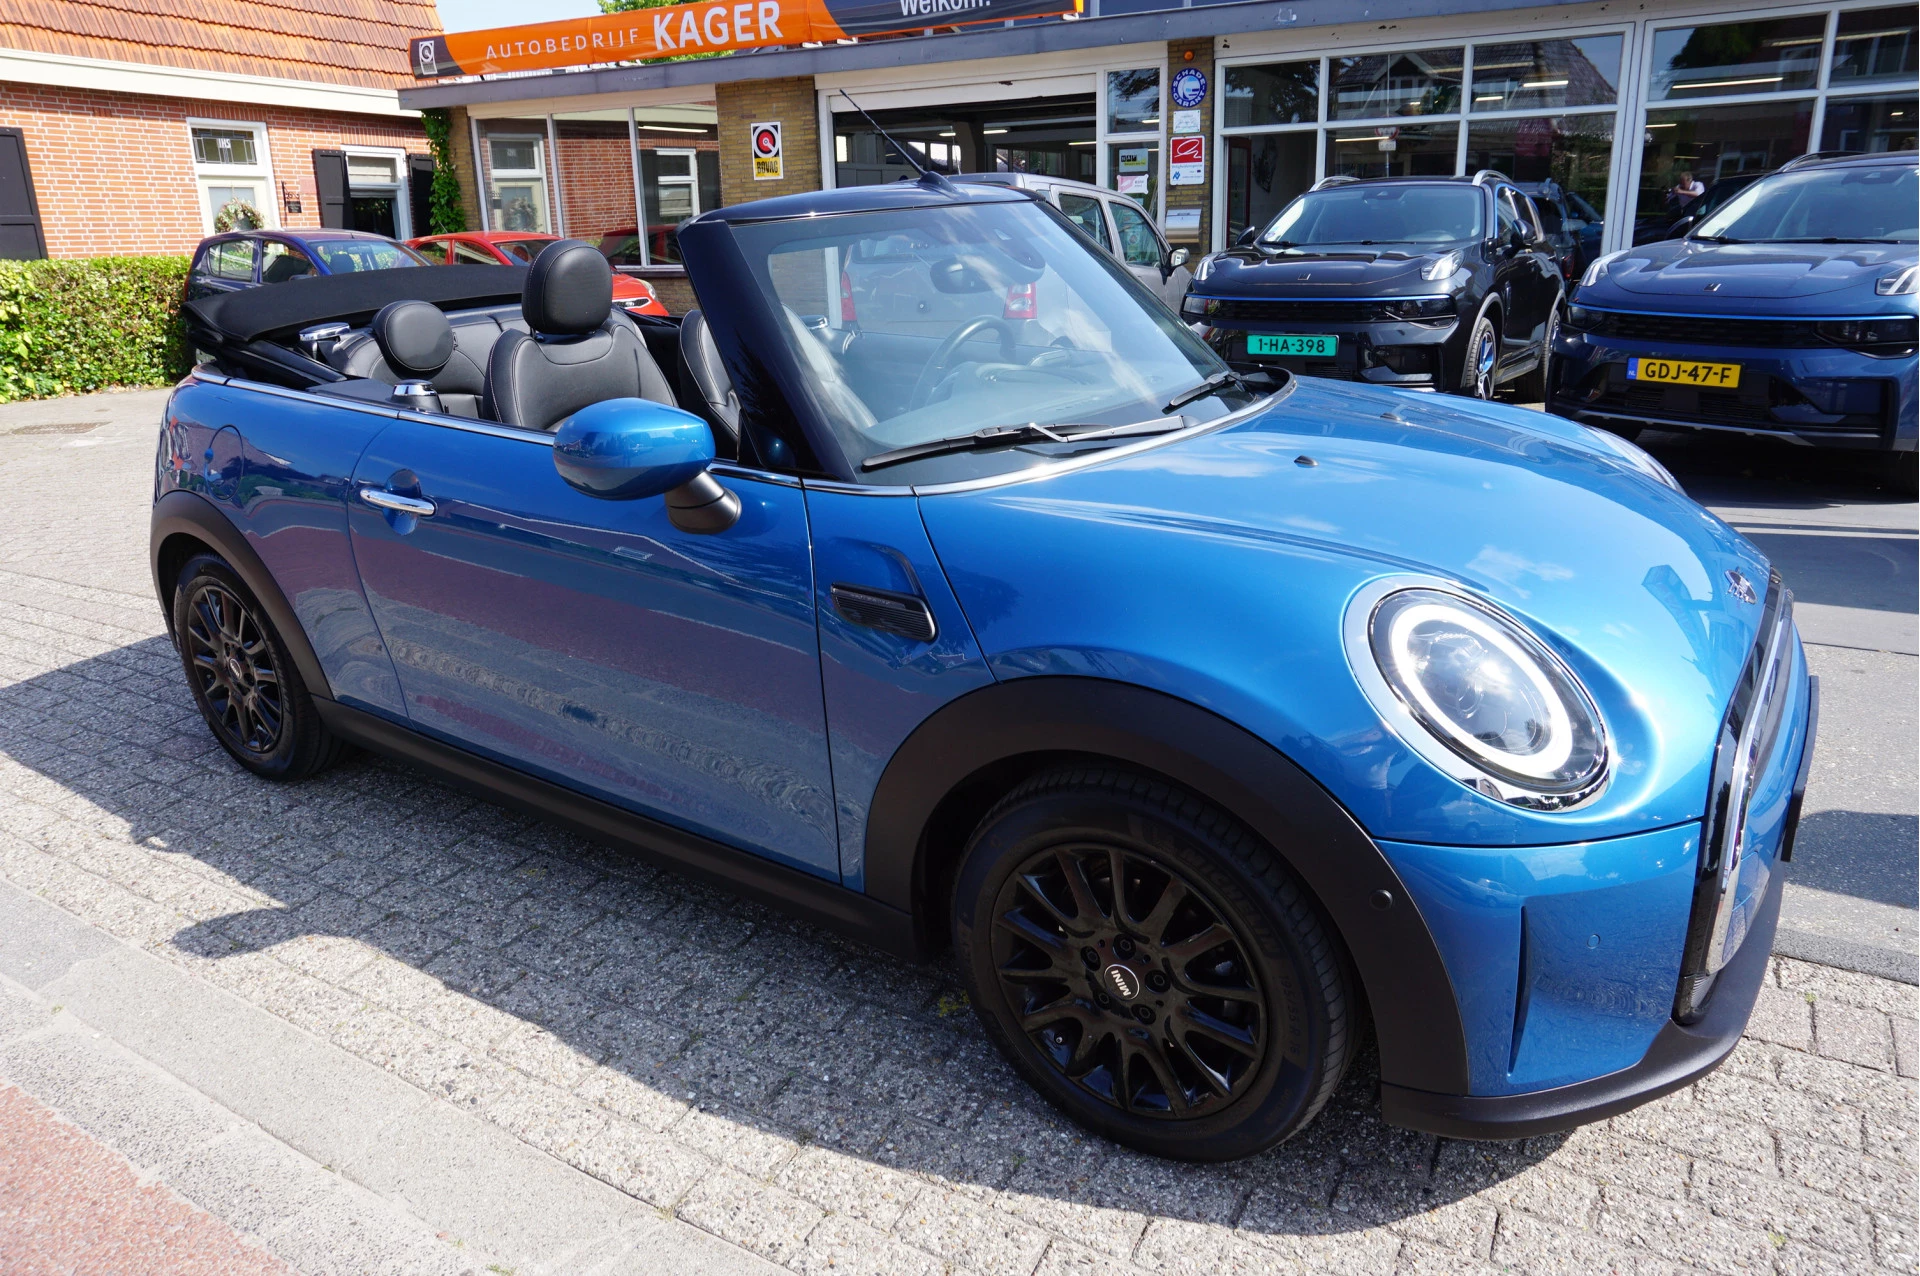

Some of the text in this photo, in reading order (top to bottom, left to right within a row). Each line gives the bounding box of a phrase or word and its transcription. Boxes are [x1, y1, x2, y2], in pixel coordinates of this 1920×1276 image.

[486, 1, 784, 60] AUTOBEDRIJF KAGER
[1258, 338, 1326, 353] 1-HA-398
[1644, 362, 1732, 383] GDJ-47-F
[1110, 969, 1132, 997] MINI
